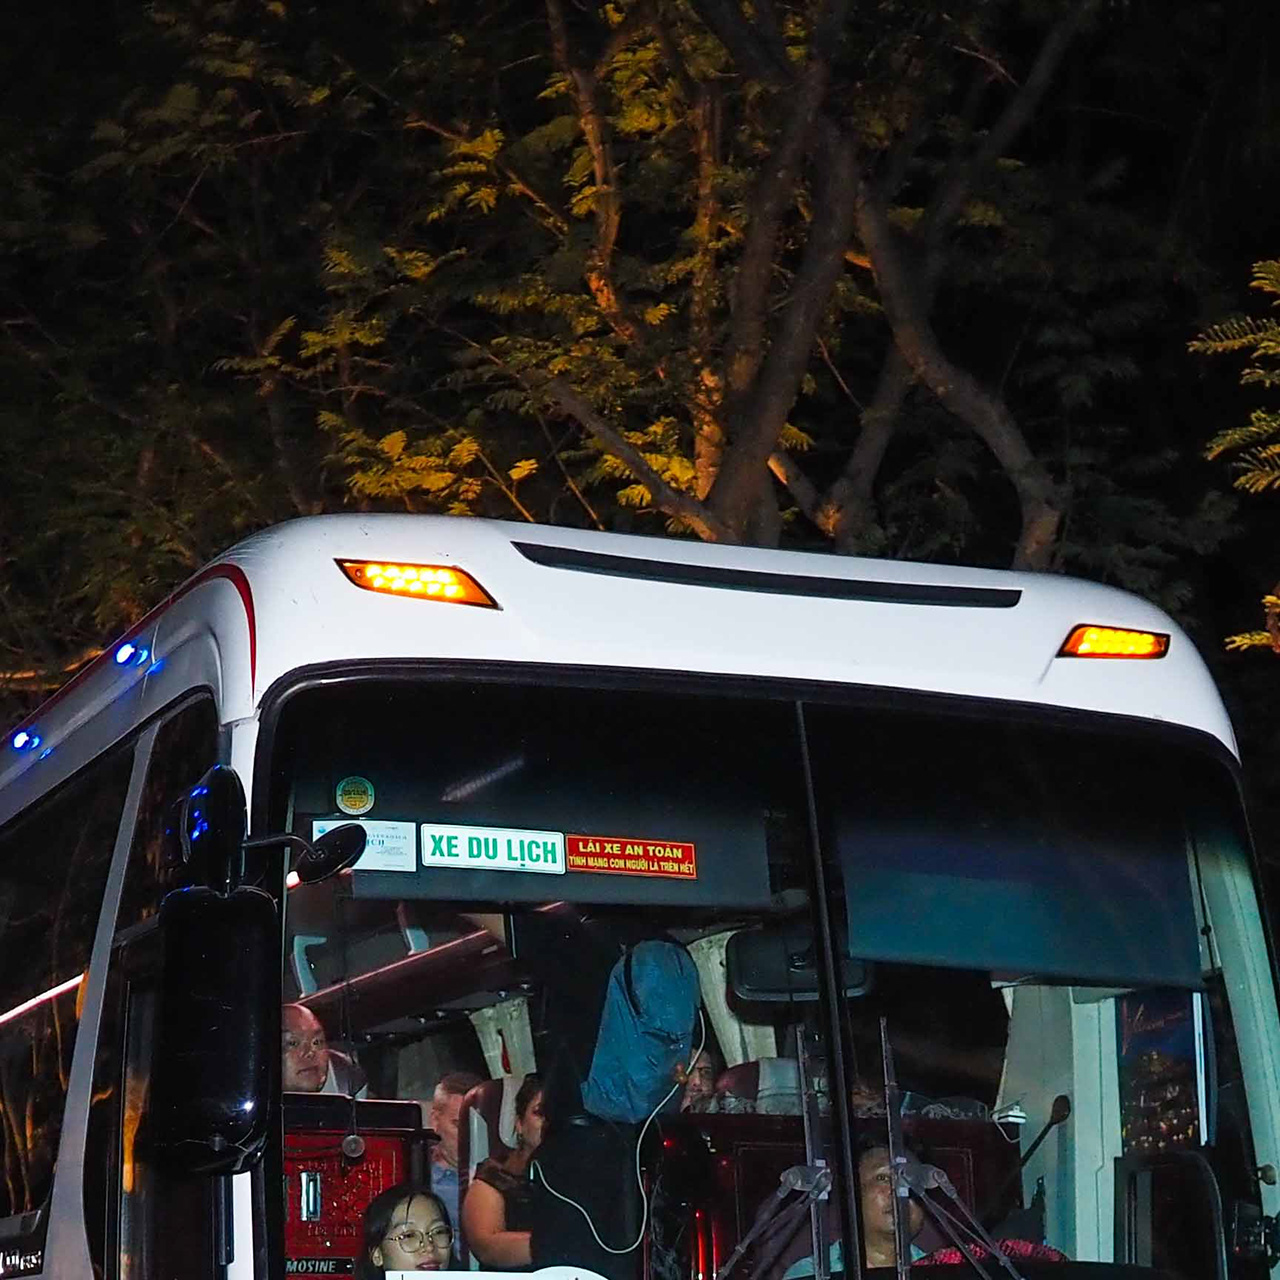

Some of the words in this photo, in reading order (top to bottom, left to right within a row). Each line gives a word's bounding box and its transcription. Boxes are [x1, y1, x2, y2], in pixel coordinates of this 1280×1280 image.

[430, 834, 459, 857] XE
[468, 836, 498, 860] DU
[506, 839, 557, 867] LỊCH
[604, 843, 621, 854] XE
[625, 844, 643, 856] AN
